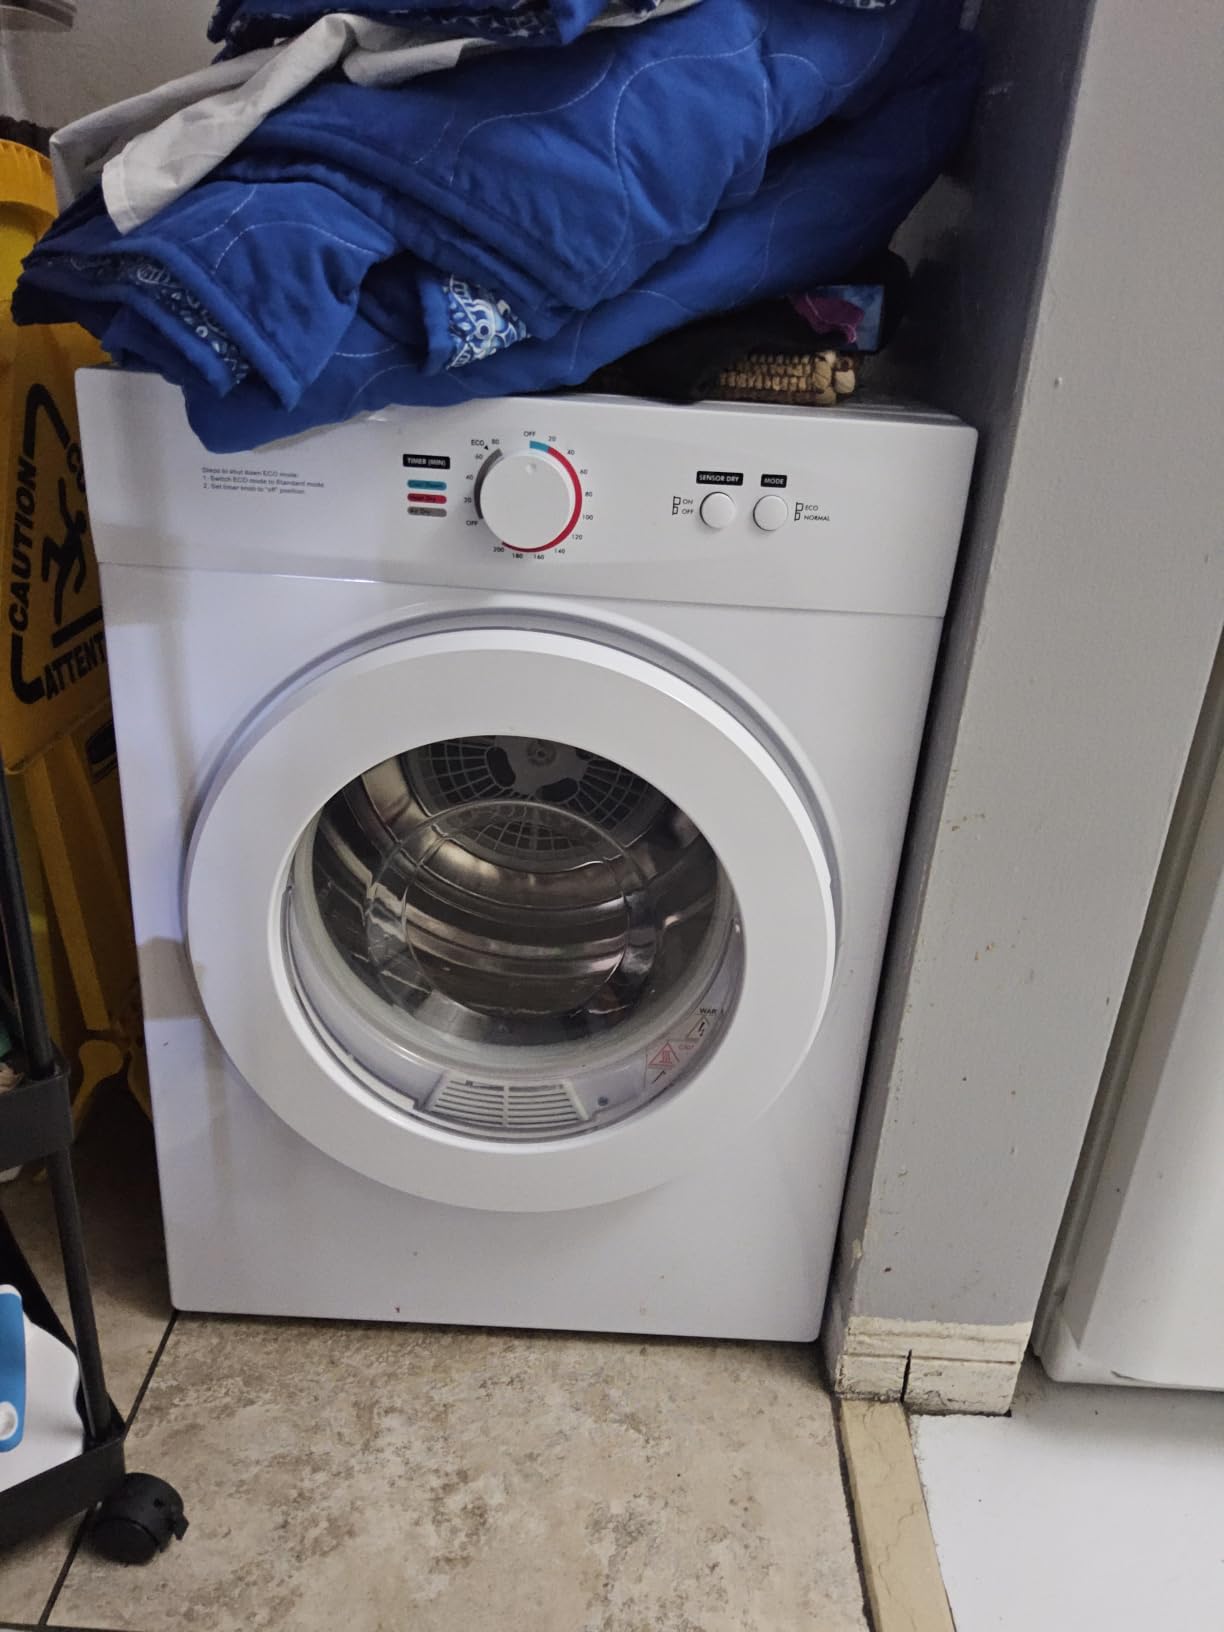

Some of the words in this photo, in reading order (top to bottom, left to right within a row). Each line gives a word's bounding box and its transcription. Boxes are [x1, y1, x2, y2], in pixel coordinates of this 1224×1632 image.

[523, 430, 536, 438] OFF
[470, 439, 485, 447] ECO
[547, 435, 557, 443] 20
[407, 457, 427, 465] TIMER
[698, 474, 726, 483] SENSOR
[726, 475, 740, 483] DRY
[763, 477, 784, 485] MODE
[584, 490, 593, 498] 80
[463, 496, 472, 504] 20
[582, 513, 594, 521] 100
[803, 514, 831, 522] NORMAL
[465, 519, 479, 527] OFF
[571, 533, 583, 541] 120
[8, 454, 38, 632] CAUTION
[493, 546, 505, 554] 200
[554, 547, 566, 555] 140
